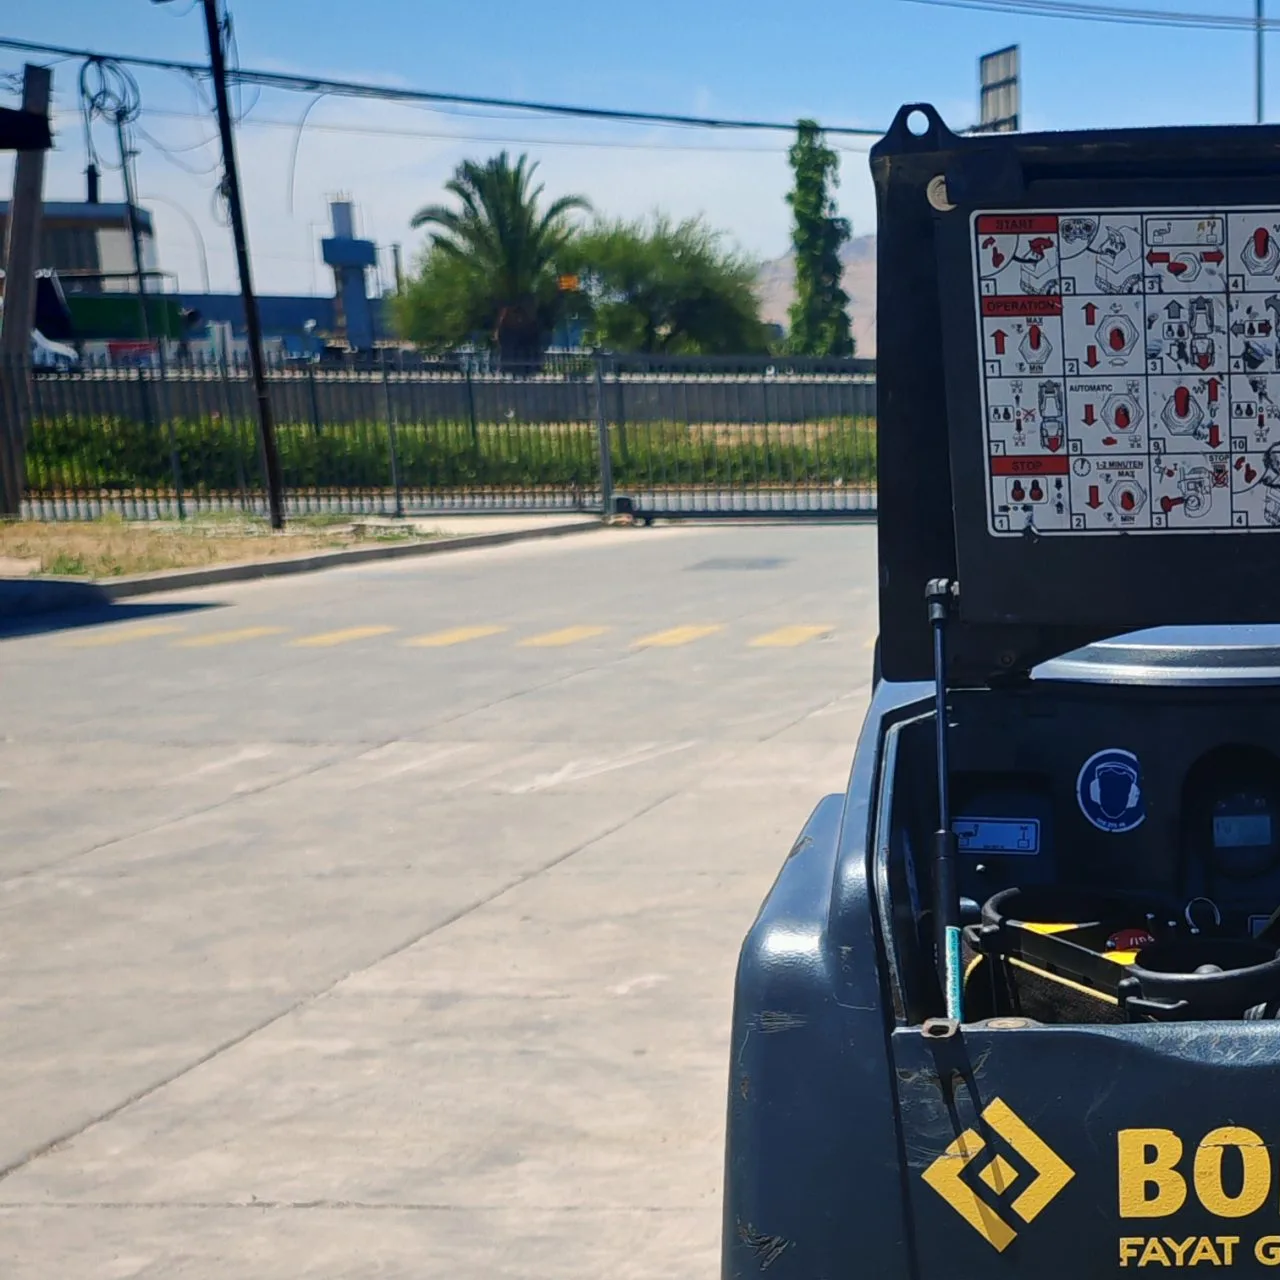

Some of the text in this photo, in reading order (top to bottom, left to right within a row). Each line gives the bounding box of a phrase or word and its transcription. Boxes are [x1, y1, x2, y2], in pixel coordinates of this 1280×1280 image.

[996, 218, 1033, 230] START
[984, 282, 991, 293] 1
[1064, 282, 1071, 292] 2
[1147, 280, 1155, 290] 3
[1231, 278, 1239, 288] 4
[987, 301, 1055, 313] OPERATION
[989, 363, 996, 374] 1
[1029, 364, 1044, 372] MIN
[1068, 362, 1075, 373] 2
[1150, 361, 1157, 371] 3
[1233, 360, 1240, 370] 4
[1069, 384, 1113, 393] AUTOMATIC
[994, 444, 1000, 453] 7
[1071, 443, 1078, 452] 8
[1153, 441, 1160, 450] 9
[1232, 439, 1245, 449] 10
[1012, 461, 1042, 472] STOP
[1096, 461, 1144, 470] 1-2 MINUTEN
[998, 519, 1004, 529] 1
[1075, 518, 1082, 527] 2
[1120, 515, 1135, 523] MIN
[1155, 516, 1162, 526] 3
[1236, 515, 1243, 524] 4
[1119, 1235, 1239, 1267] FAYAT
